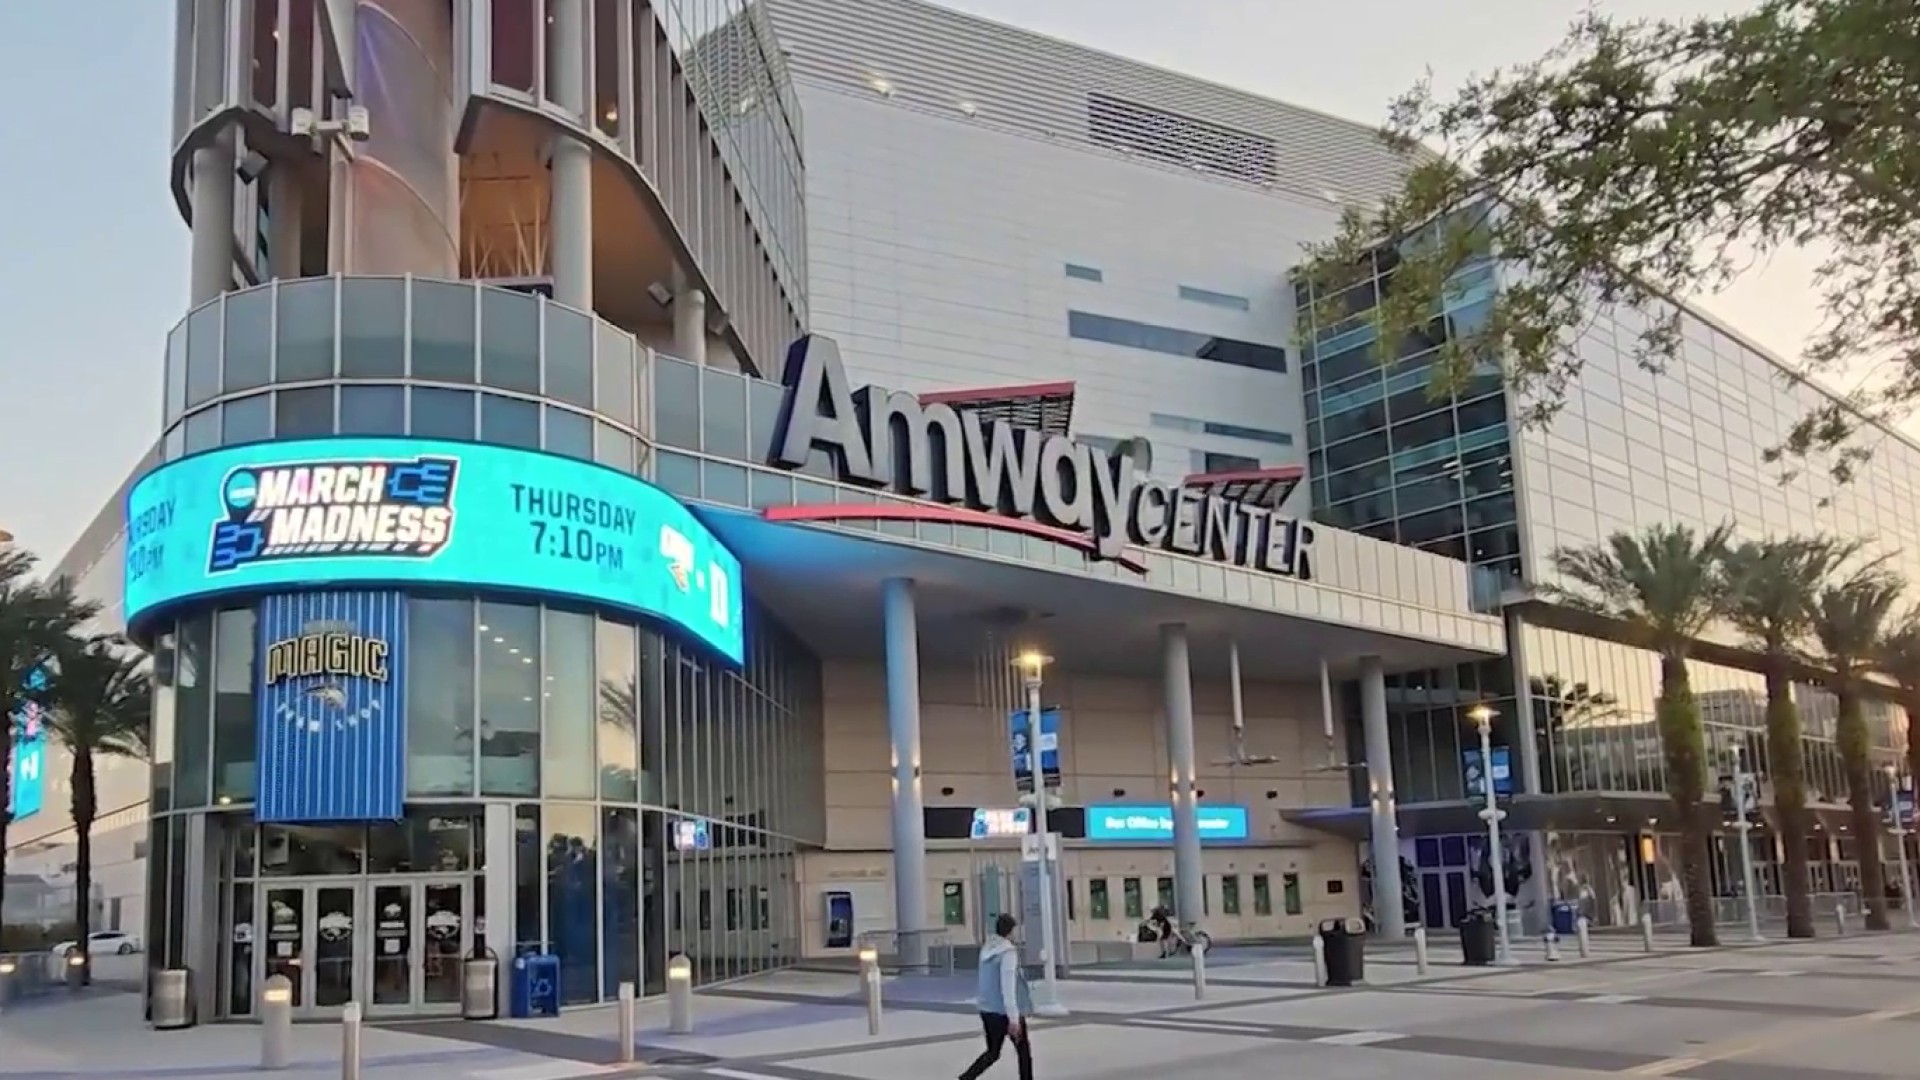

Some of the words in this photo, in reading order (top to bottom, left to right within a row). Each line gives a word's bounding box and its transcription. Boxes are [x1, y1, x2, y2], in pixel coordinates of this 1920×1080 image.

[776, 333, 1134, 560] Amway
[1129, 481, 1319, 581] CENTER
[256, 465, 387, 508] MARCH
[510, 483, 636, 536] THURSDAY
[268, 504, 452, 545] MADNESS
[530, 520, 624, 571] 7:10PM
[265, 632, 389, 686] MAGIC
